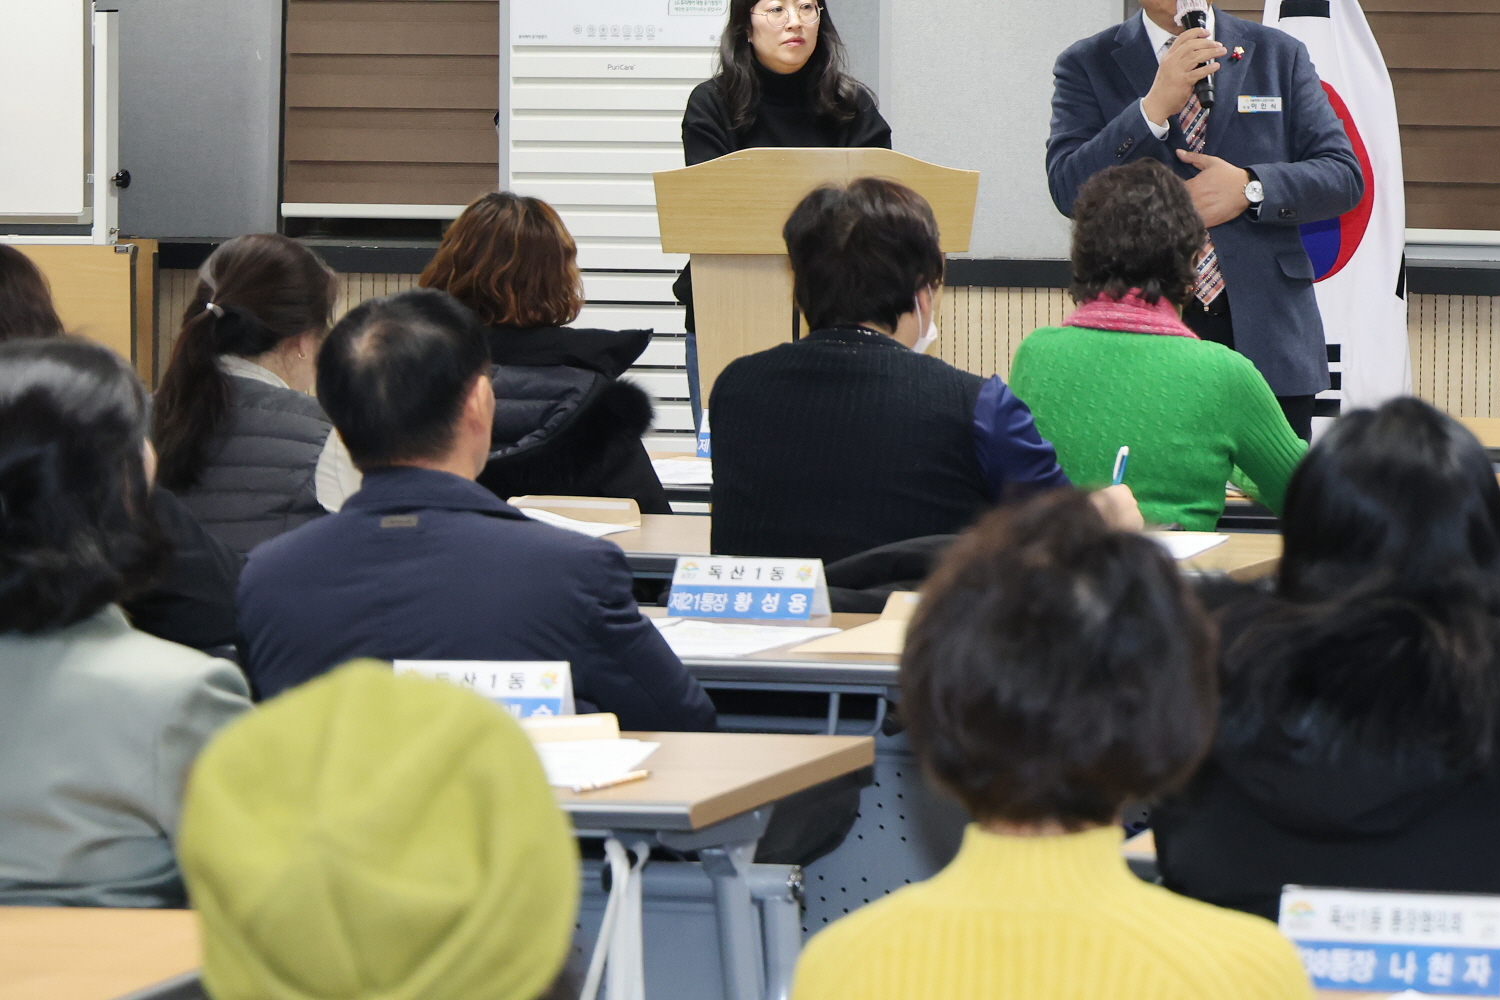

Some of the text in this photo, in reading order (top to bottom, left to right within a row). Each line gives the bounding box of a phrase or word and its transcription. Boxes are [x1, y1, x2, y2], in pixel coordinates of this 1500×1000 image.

[708, 565, 784, 581] 독산1동
[669, 591, 808, 614] 제21통장 황성용
